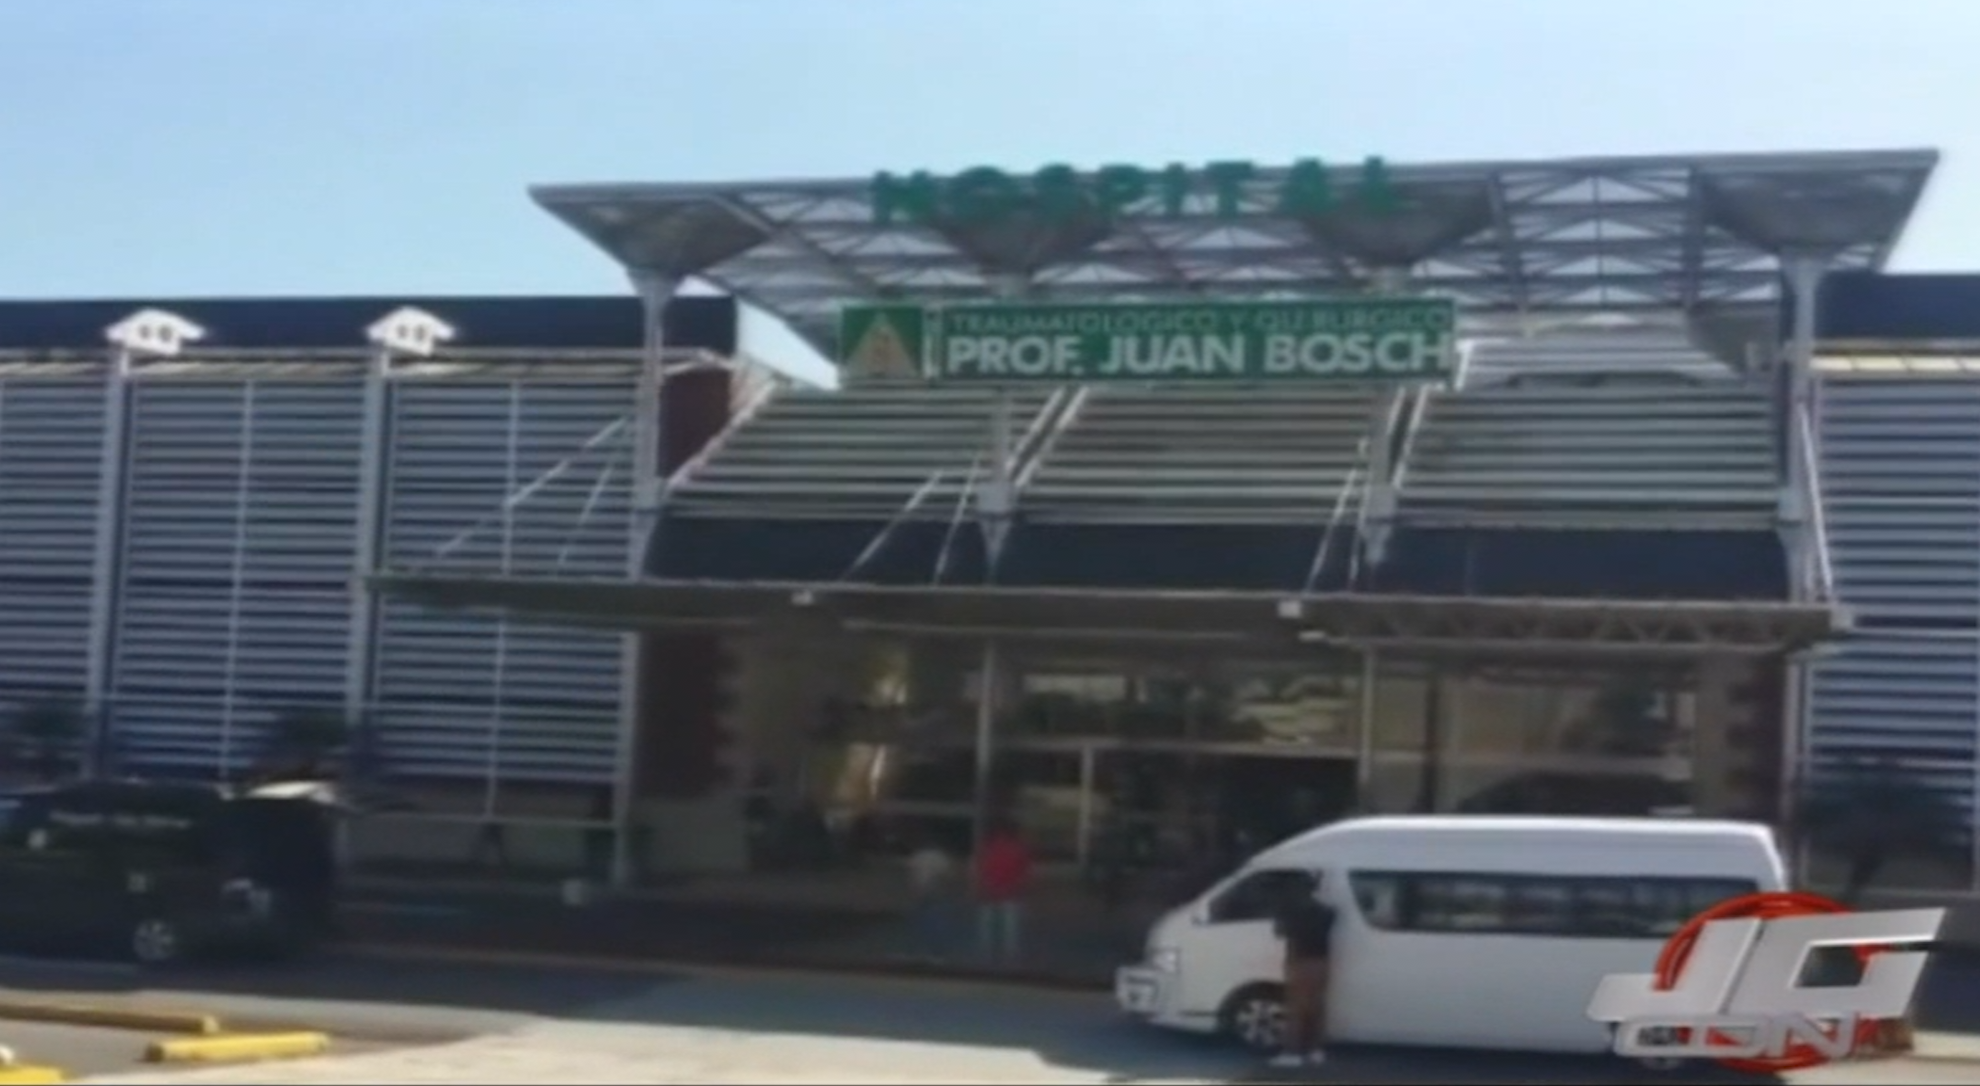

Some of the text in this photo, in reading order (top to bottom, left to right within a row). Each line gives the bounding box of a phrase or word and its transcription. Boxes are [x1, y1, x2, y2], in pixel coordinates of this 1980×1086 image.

[870, 155, 1404, 230] HOSPITAL
[1229, 309, 1247, 330] Y
[946, 332, 1451, 376] PROF. JUAN BOSCH
